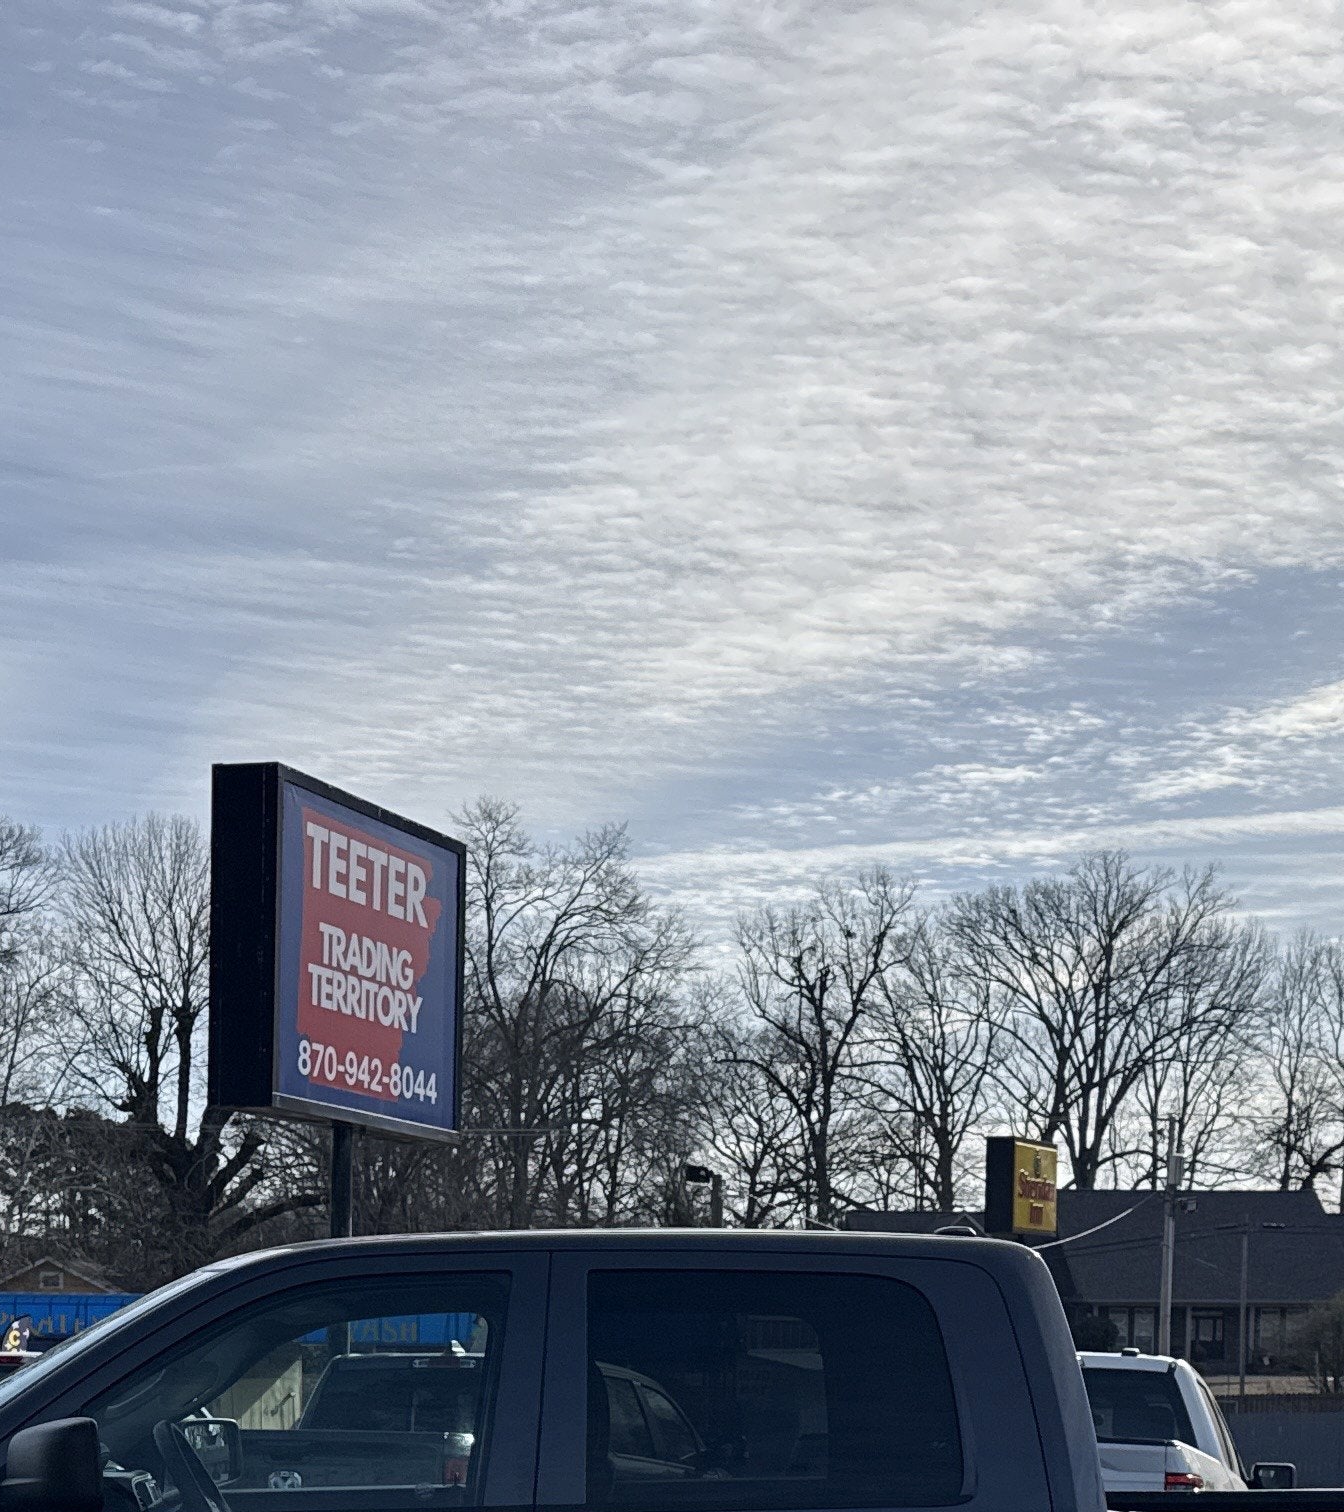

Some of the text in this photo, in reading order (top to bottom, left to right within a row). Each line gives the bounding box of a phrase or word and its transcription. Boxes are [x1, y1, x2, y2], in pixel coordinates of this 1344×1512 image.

[307, 821, 428, 928] TEETER
[319, 922, 413, 990] TRADING
[308, 963, 423, 1034] TERRITORY
[298, 1040, 437, 1104] 870-942-8044
